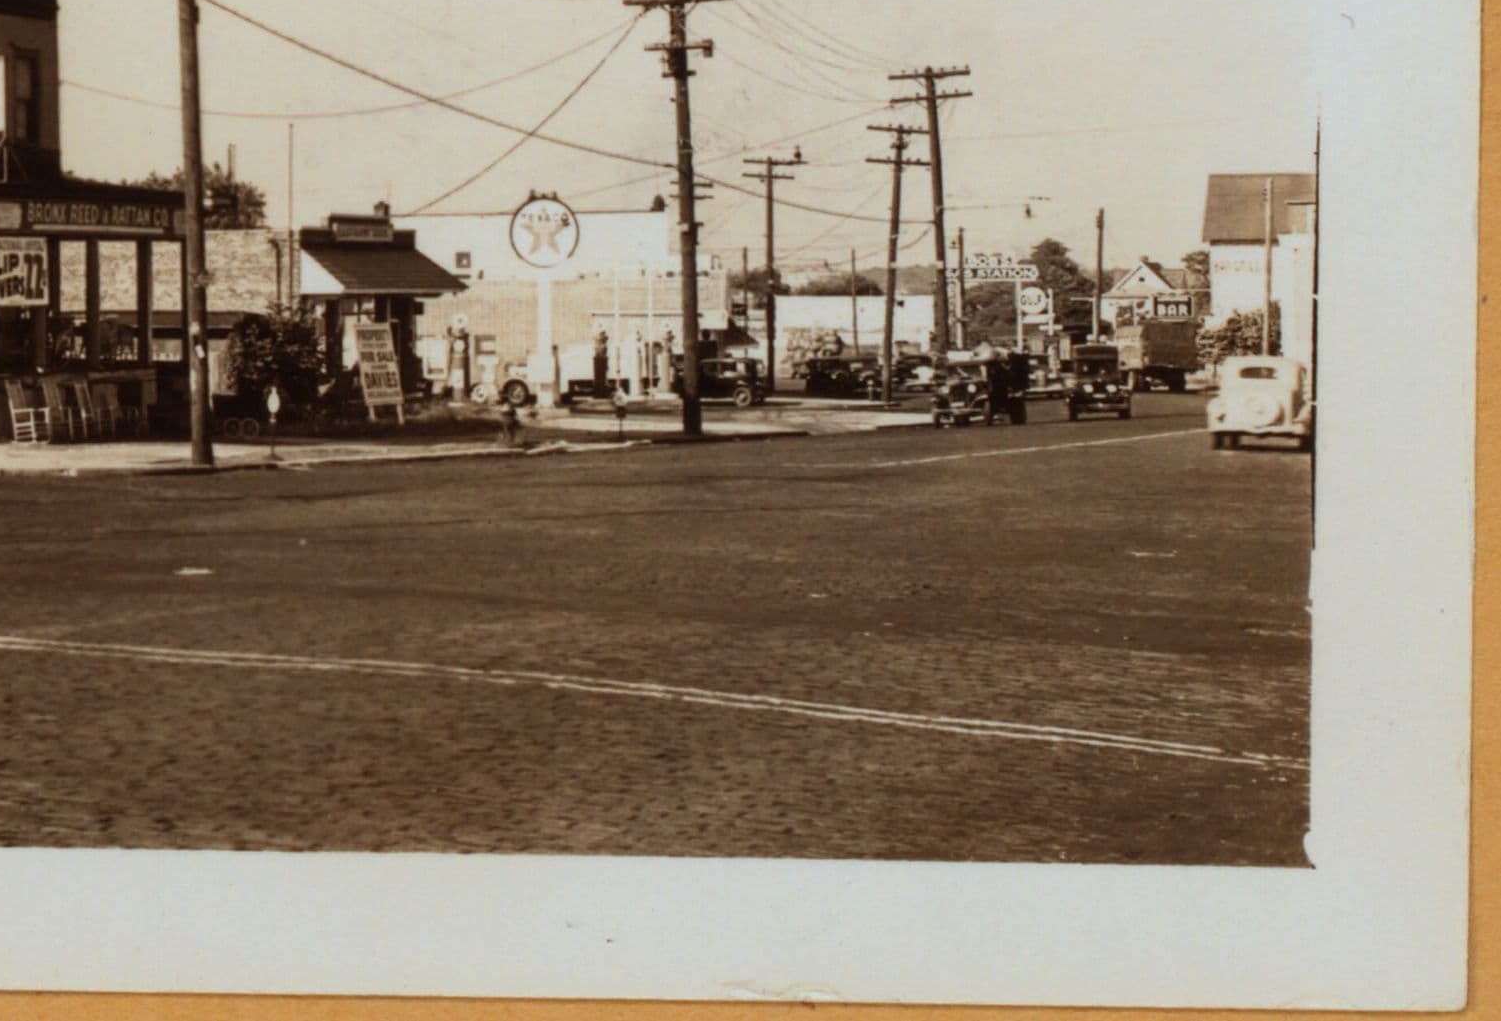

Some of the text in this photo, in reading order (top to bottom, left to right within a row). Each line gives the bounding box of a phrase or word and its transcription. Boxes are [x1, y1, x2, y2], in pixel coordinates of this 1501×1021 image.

[27, 202, 67, 224] BRONX
[70, 204, 99, 225] REED
[111, 206, 150, 227] RATTAN
[976, 267, 1036, 279] STATION
[1156, 303, 1188, 317] BAR
[376, 350, 394, 363] SALE
